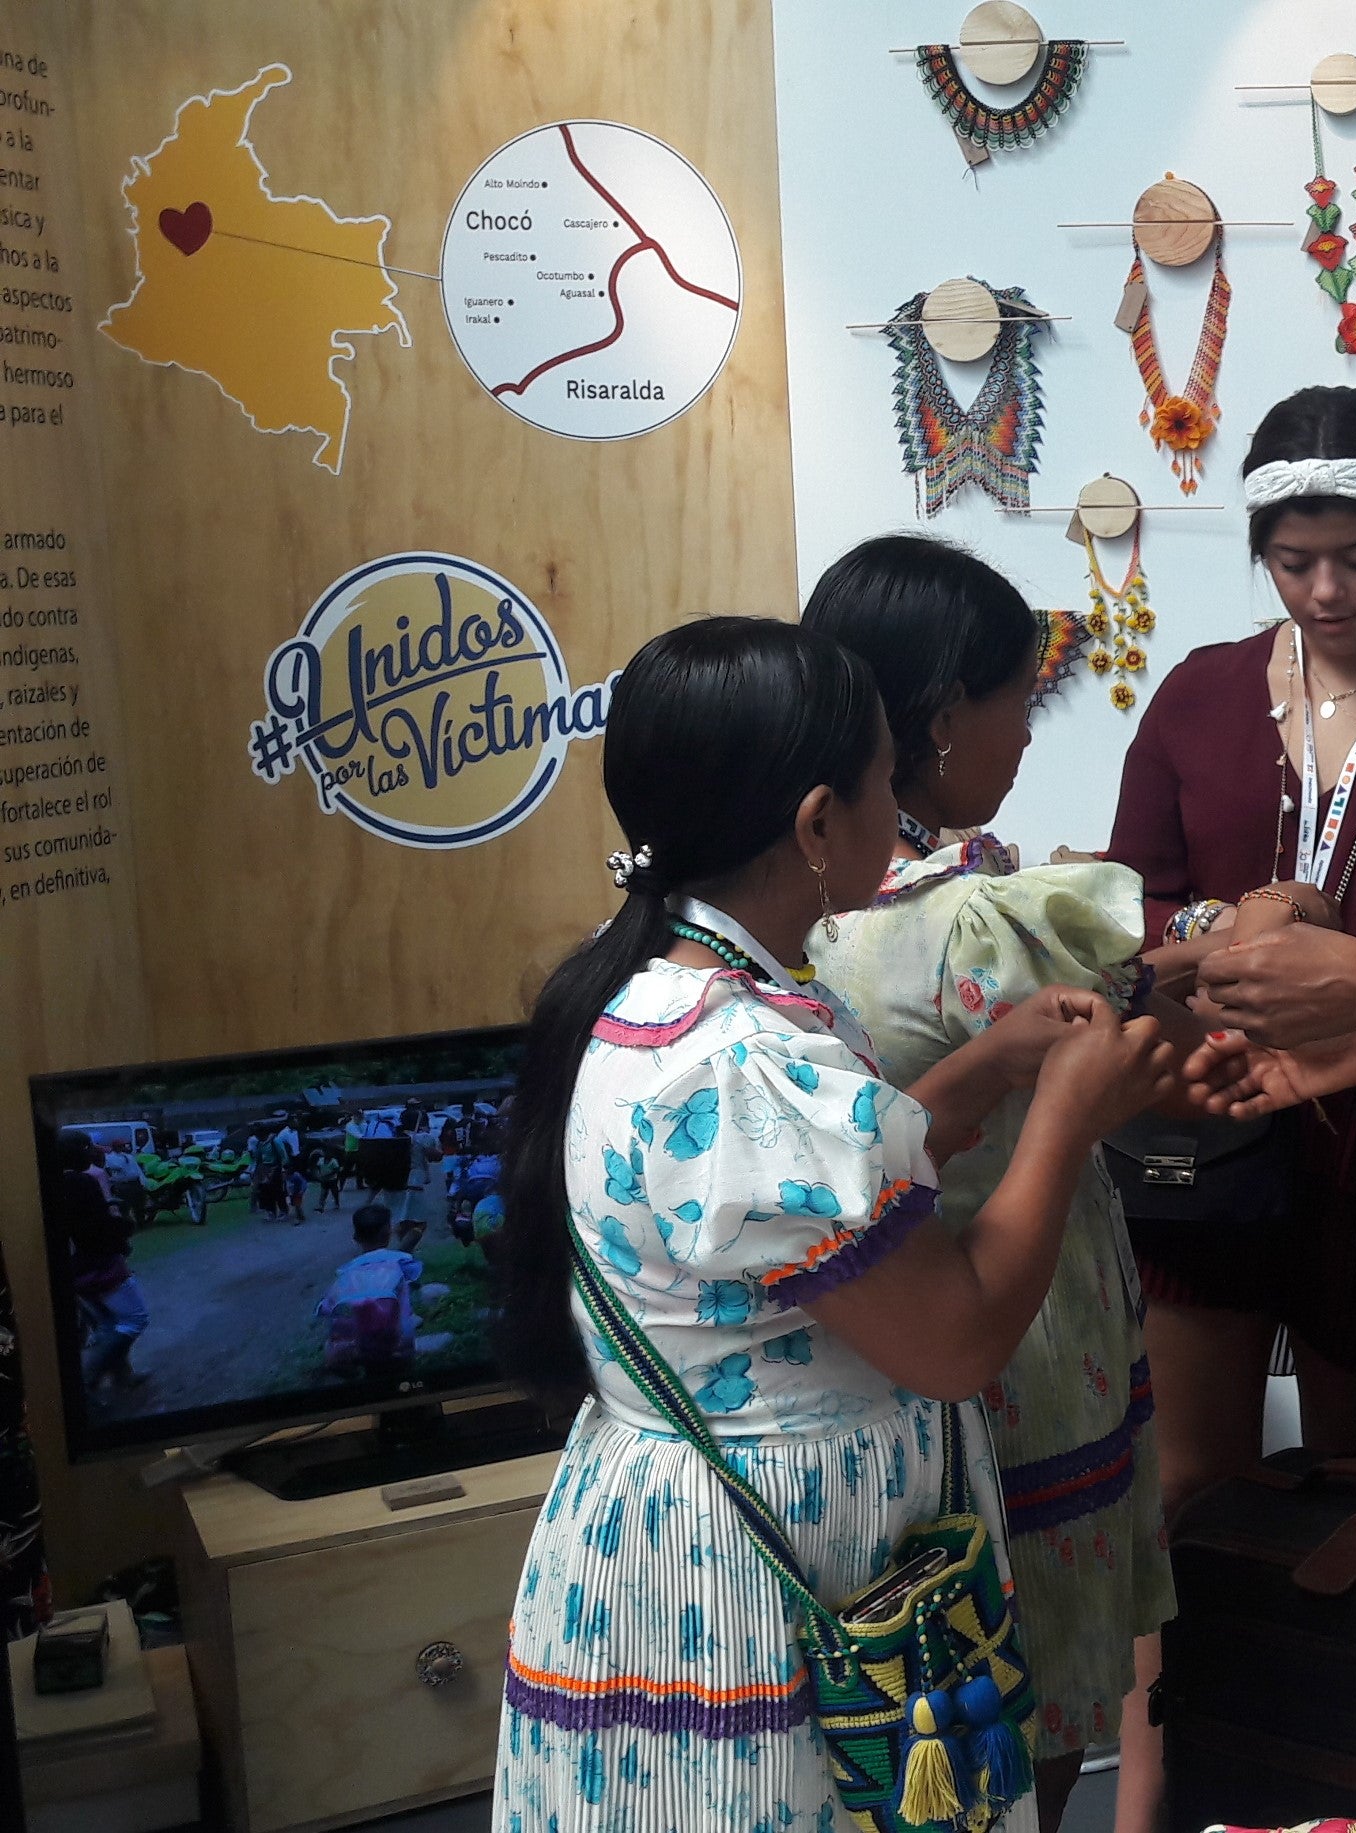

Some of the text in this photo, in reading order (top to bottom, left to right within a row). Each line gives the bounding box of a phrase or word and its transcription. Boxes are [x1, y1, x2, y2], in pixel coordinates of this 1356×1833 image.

[0, 52, 48, 78] na de
[20, 128, 34, 151] la
[484, 178, 503, 189] Alto
[0, 205, 45, 238] sica y
[466, 209, 533, 231] Chocó
[563, 218, 609, 231] Cascajero
[45, 249, 60, 273] la
[483, 251, 528, 262] Pescadito
[536, 270, 585, 281] Ocotumbo
[3, 286, 73, 313] aspectos
[464, 297, 504, 308] Iguanero
[559, 288, 596, 300] Aguasal
[465, 314, 491, 324] Irakal
[3, 360, 74, 388] hermoso
[566, 378, 666, 401] Risaralda
[11, 406, 46, 427] para
[50, 404, 63, 426] el
[4, 529, 66, 550] armado
[17, 567, 39, 588] De
[43, 570, 77, 588] esas
[0, 606, 78, 628] do contra
[8, 681, 67, 706] raizales
[70, 684, 79, 707] y
[71, 716, 90, 738] de
[87, 750, 106, 774] de
[319, 755, 410, 809] por las
[1, 786, 112, 824] fortalece el rol
[4, 826, 117, 863] sus comunida-
[10, 881, 31, 901] en
[35, 866, 110, 897] definitiva,
